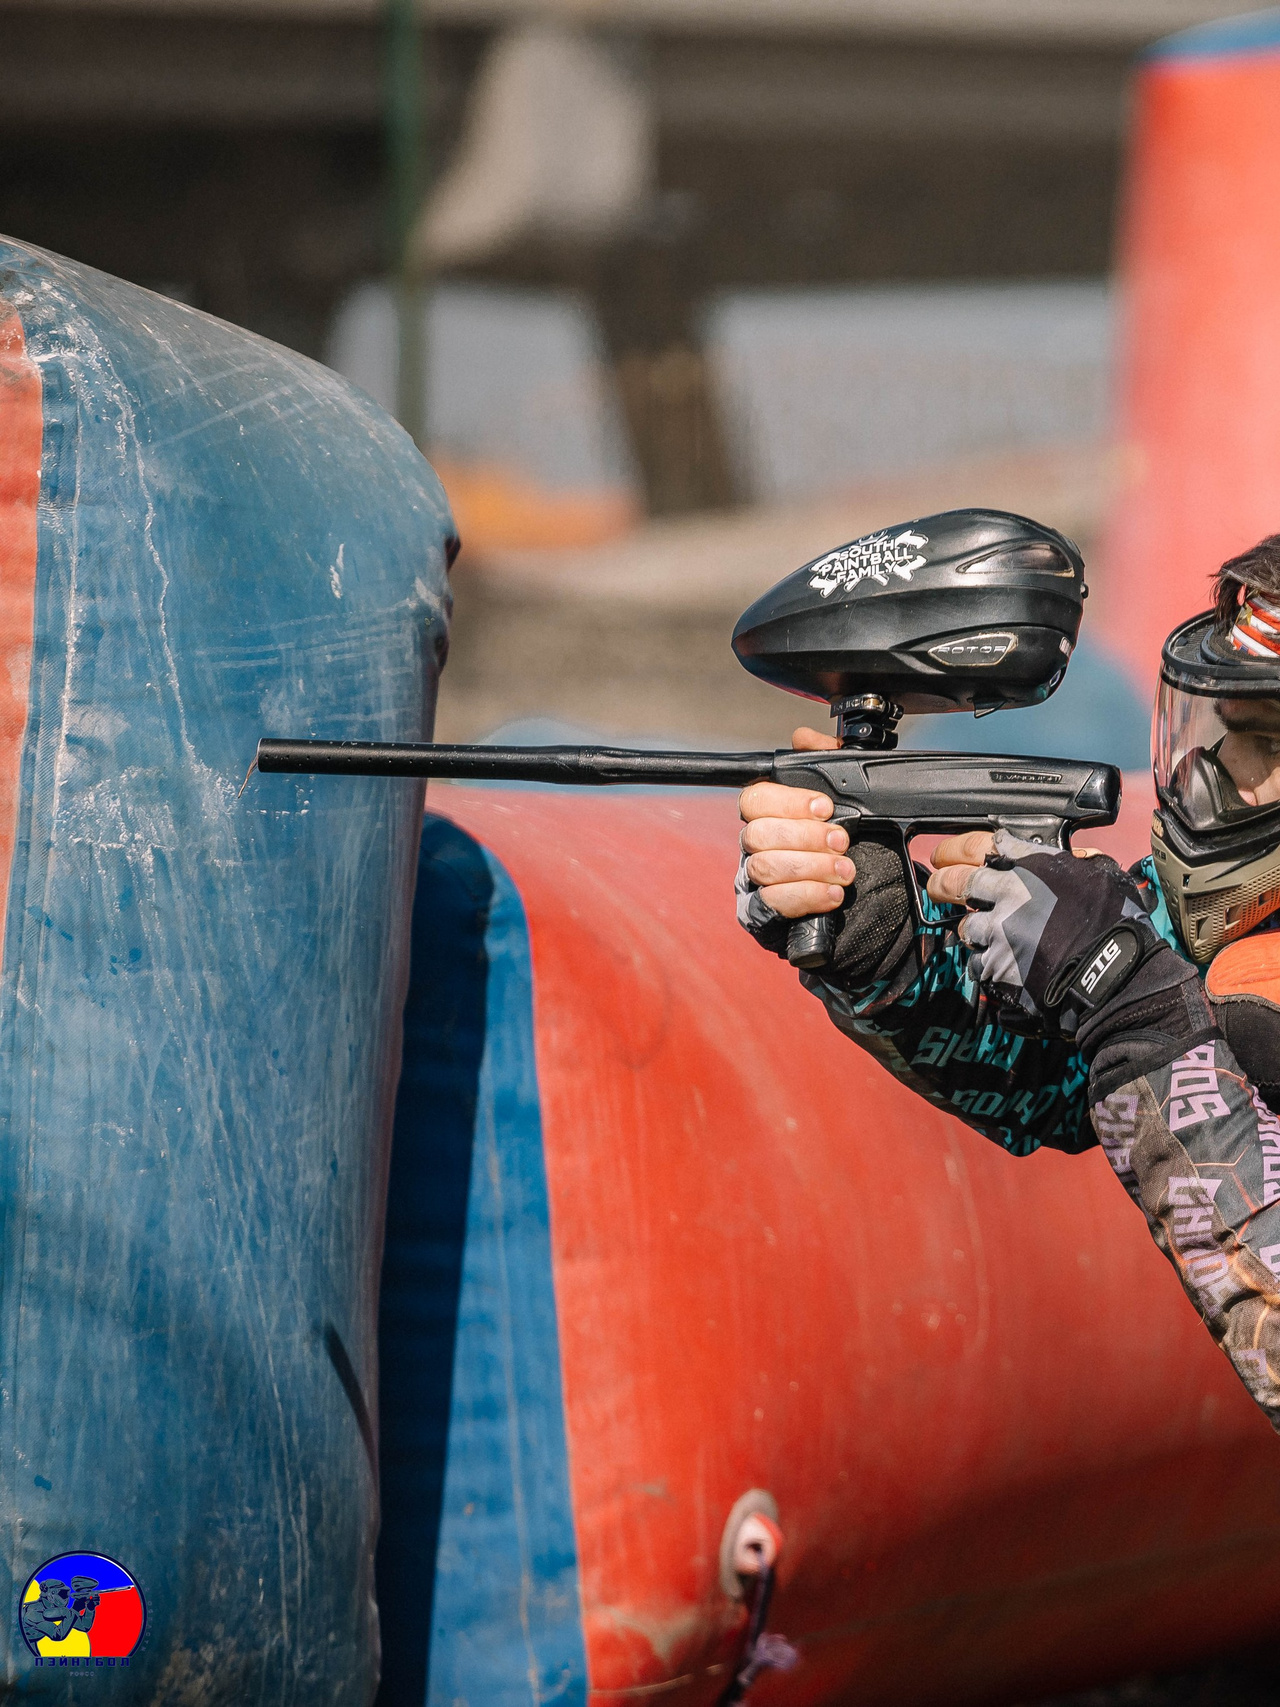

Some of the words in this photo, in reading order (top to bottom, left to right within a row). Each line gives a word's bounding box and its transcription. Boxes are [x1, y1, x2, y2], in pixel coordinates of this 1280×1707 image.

[821, 547, 914, 577] PAINTBALL
[840, 539, 896, 562] SOUTH
[836, 560, 896, 585] FAMILY
[937, 645, 1007, 654] ROTOR
[1080, 938, 1121, 993] STG
